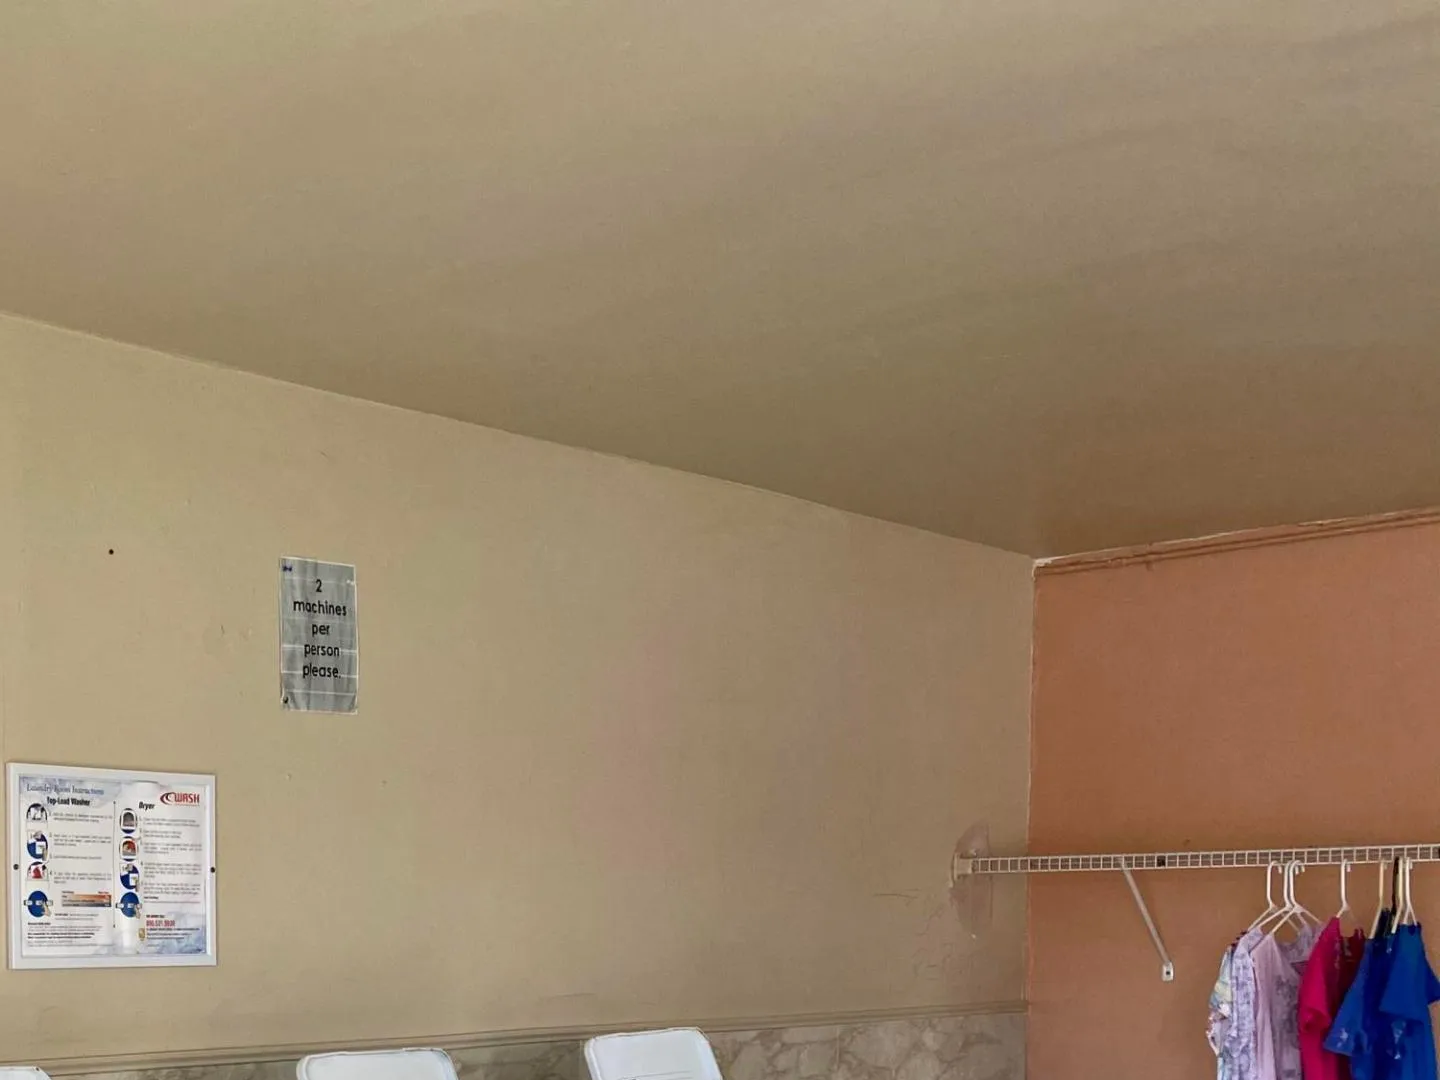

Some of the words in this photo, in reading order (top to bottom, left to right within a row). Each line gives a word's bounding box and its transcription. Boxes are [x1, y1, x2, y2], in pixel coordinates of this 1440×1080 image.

[315, 579, 322, 593] 2
[293, 600, 347, 616] machines
[311, 624, 330, 636] per
[304, 643, 340, 657] person
[302, 663, 341, 679] please.
[174, 792, 200, 803] WASH
[138, 801, 155, 811] Dryer
